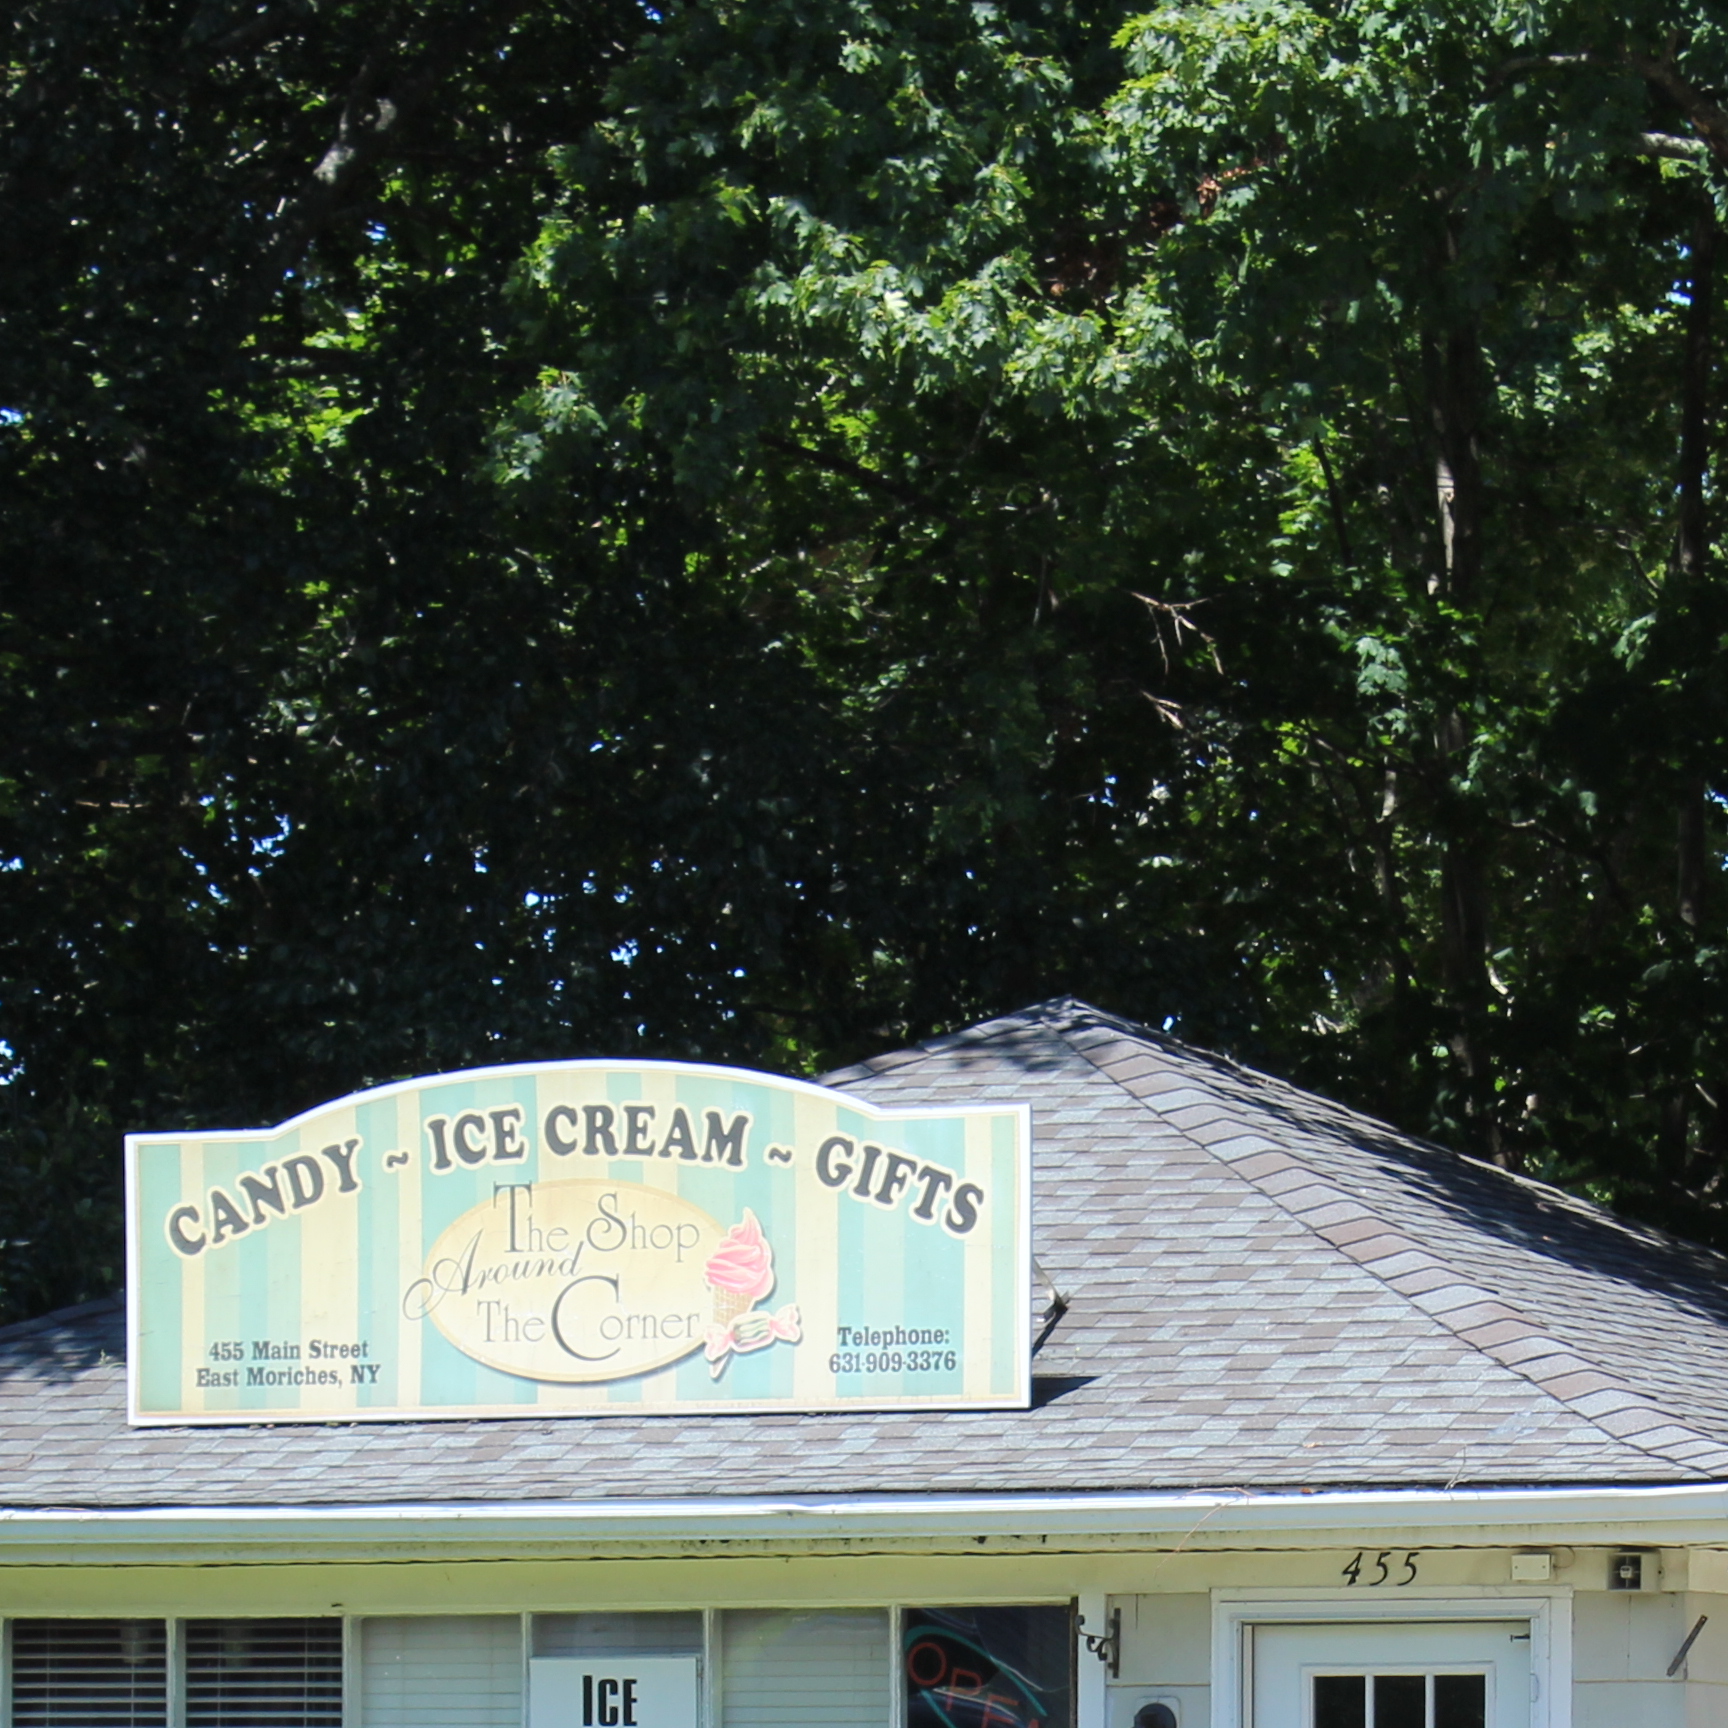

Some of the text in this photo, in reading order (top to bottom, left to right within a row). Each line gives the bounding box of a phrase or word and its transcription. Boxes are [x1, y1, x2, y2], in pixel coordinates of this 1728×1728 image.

[170, 1137, 360, 1256] CANDY
[427, 1108, 525, 1170] ICE
[544, 1104, 750, 1167] CREAM
[815, 1135, 984, 1235] GIFTS
[493, 1180, 700, 1263] The Shop
[403, 1228, 585, 1320] Around
[476, 1273, 700, 1362] The Corner
[837, 1325, 950, 1350] Telephone:
[195, 1364, 382, 1389] East Moriches, NY
[208, 1339, 369, 1362] 455 Main Street
[1342, 1551, 1420, 1586] 455
[581, 1674, 638, 1728] ICE
